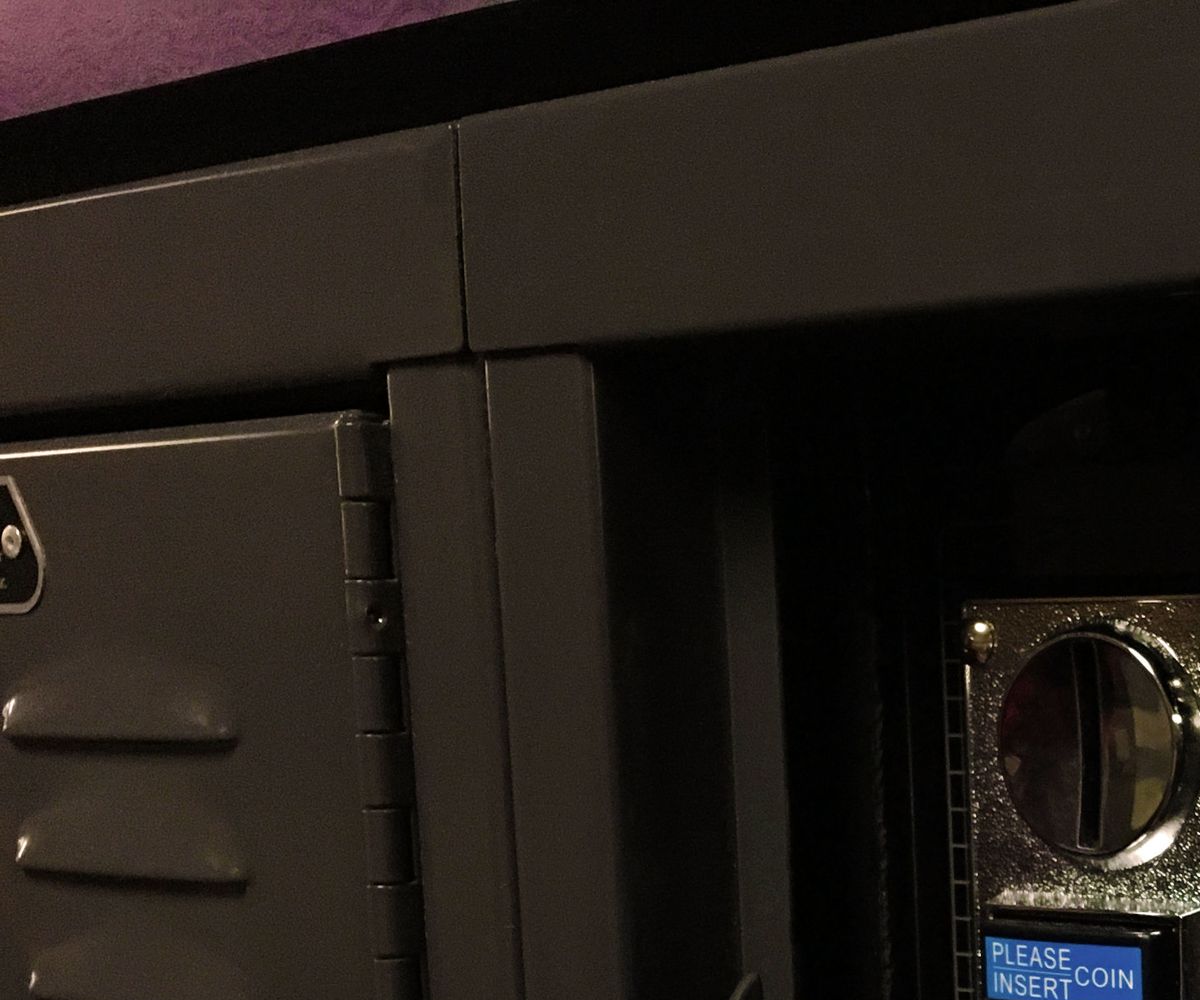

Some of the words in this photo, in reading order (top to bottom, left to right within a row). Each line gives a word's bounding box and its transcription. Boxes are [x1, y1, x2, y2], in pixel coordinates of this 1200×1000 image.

[992, 942, 1072, 971] PLEASE
[993, 971, 1073, 1000] INSERT
[1074, 966, 1134, 990] COIN
